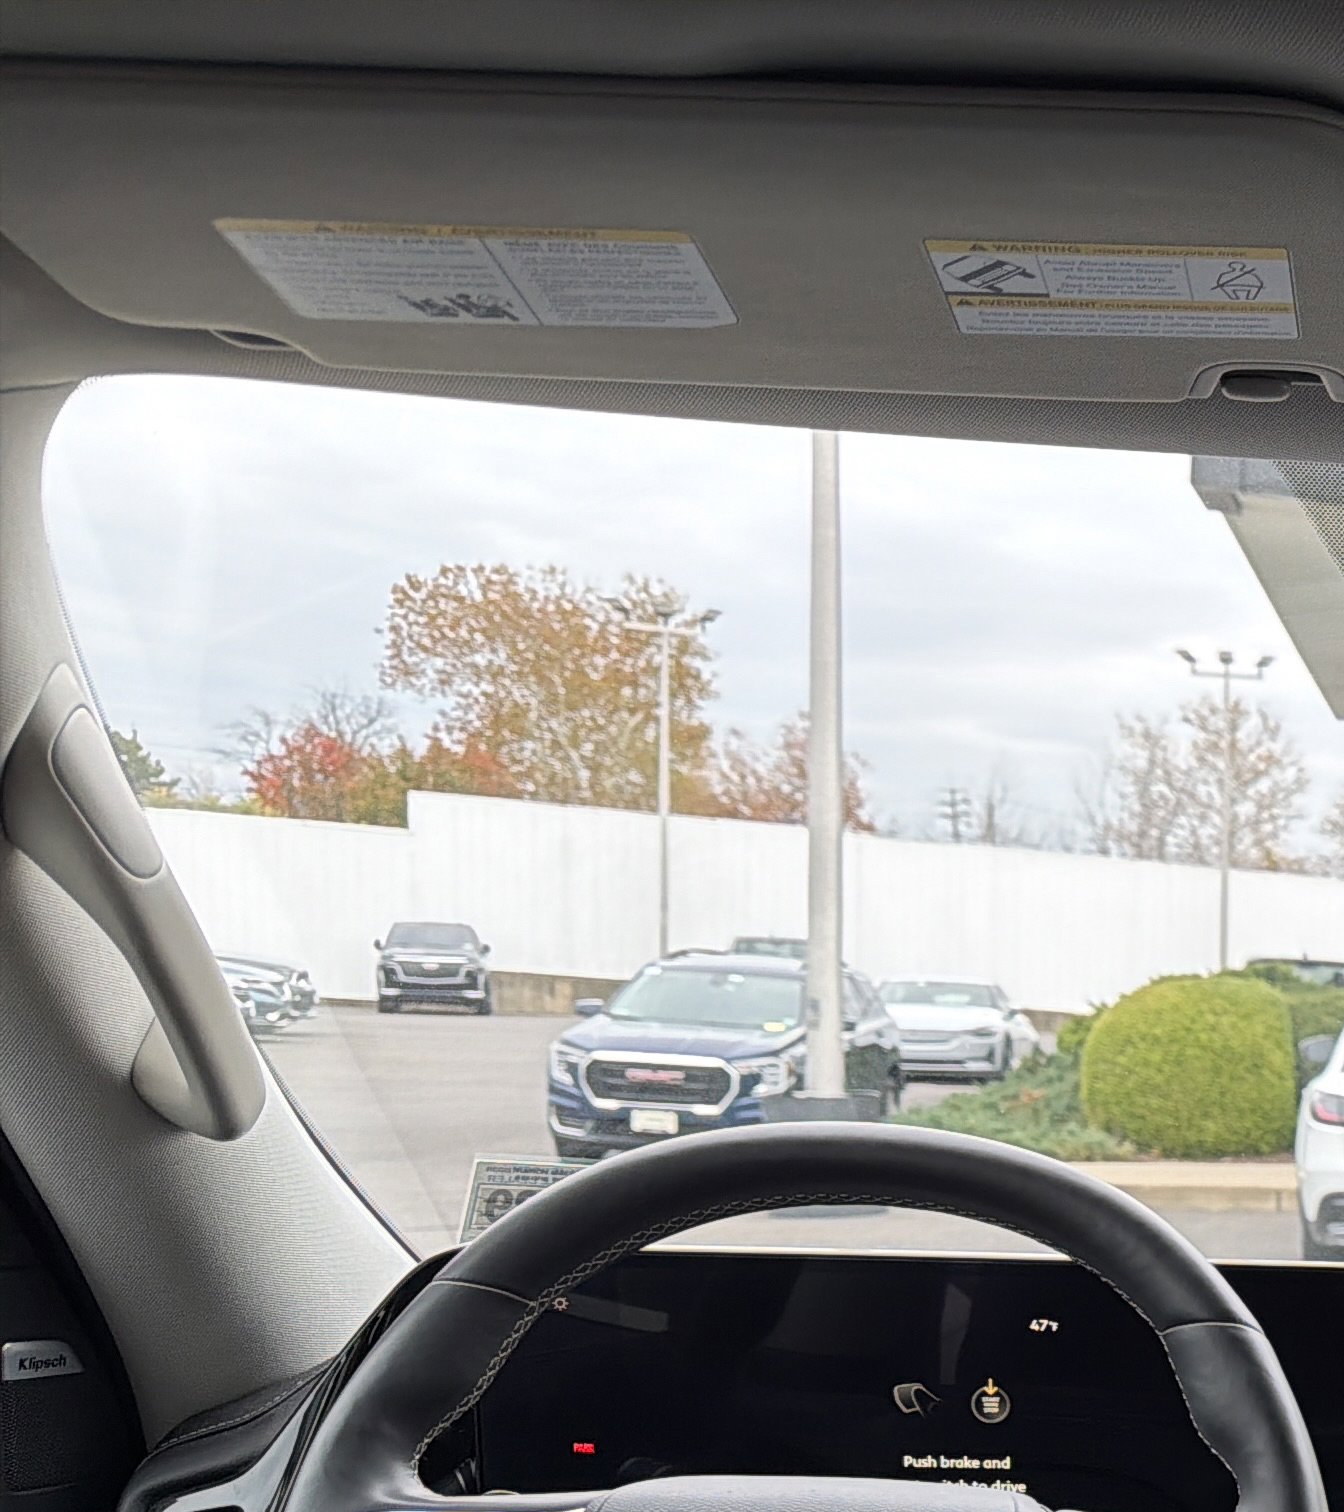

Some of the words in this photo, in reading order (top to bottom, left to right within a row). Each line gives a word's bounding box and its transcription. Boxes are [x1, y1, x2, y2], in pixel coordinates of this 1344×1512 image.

[992, 243, 1081, 254] WARNING
[18, 1354, 67, 1372] Klipsch
[903, 1455, 937, 1468] Push
[940, 1455, 980, 1469] brake
[983, 1455, 1011, 1470] and
[991, 1479, 1027, 1493] drive
